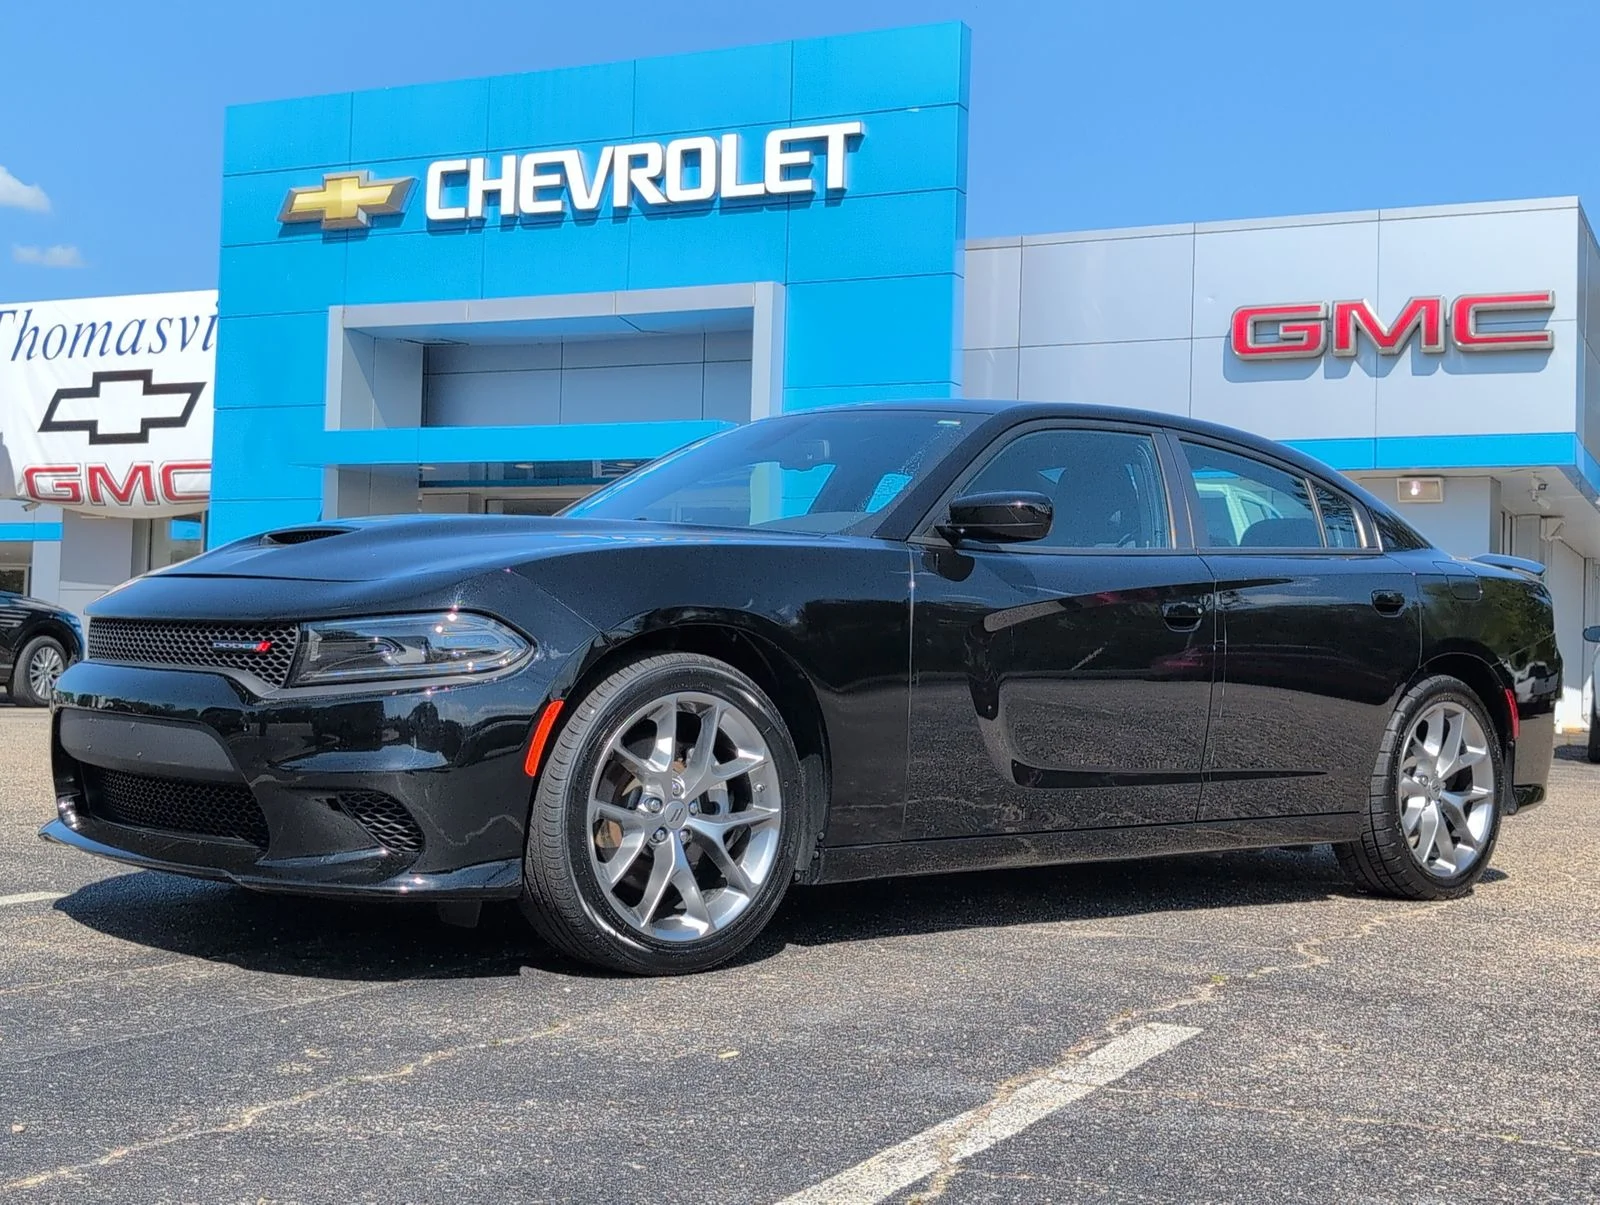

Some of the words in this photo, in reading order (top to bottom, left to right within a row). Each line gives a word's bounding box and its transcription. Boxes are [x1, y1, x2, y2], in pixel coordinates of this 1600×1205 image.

[426, 121, 865, 222] CHEVROLET
[1231, 290, 1555, 361] GMC
[24, 460, 212, 506] GMC
